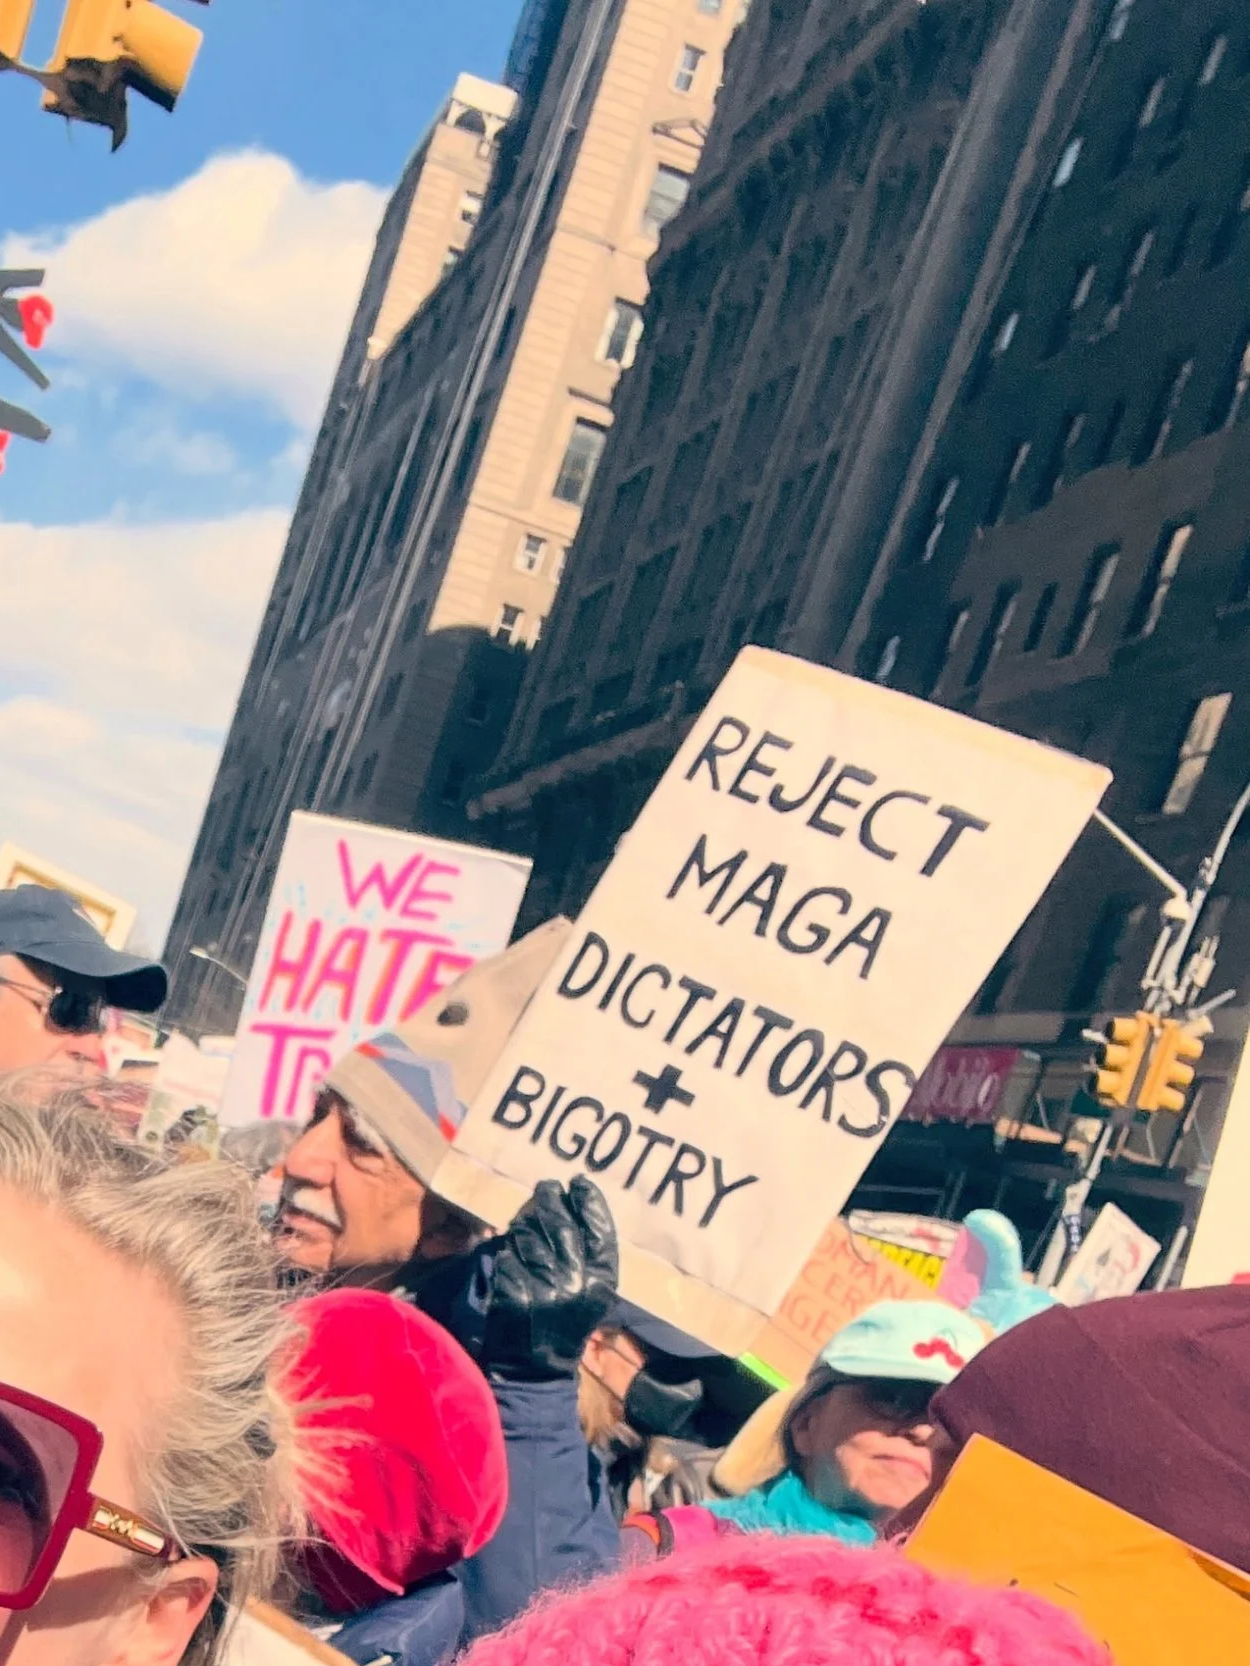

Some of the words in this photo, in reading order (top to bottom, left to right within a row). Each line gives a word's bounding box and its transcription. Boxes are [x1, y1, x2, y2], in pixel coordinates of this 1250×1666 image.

[685, 716, 990, 877] REJECT
[337, 839, 461, 921] WE
[666, 833, 893, 980] MAGA
[557, 932, 917, 1138] DICTATORS
[491, 1065, 759, 1228] BIGOTRY
